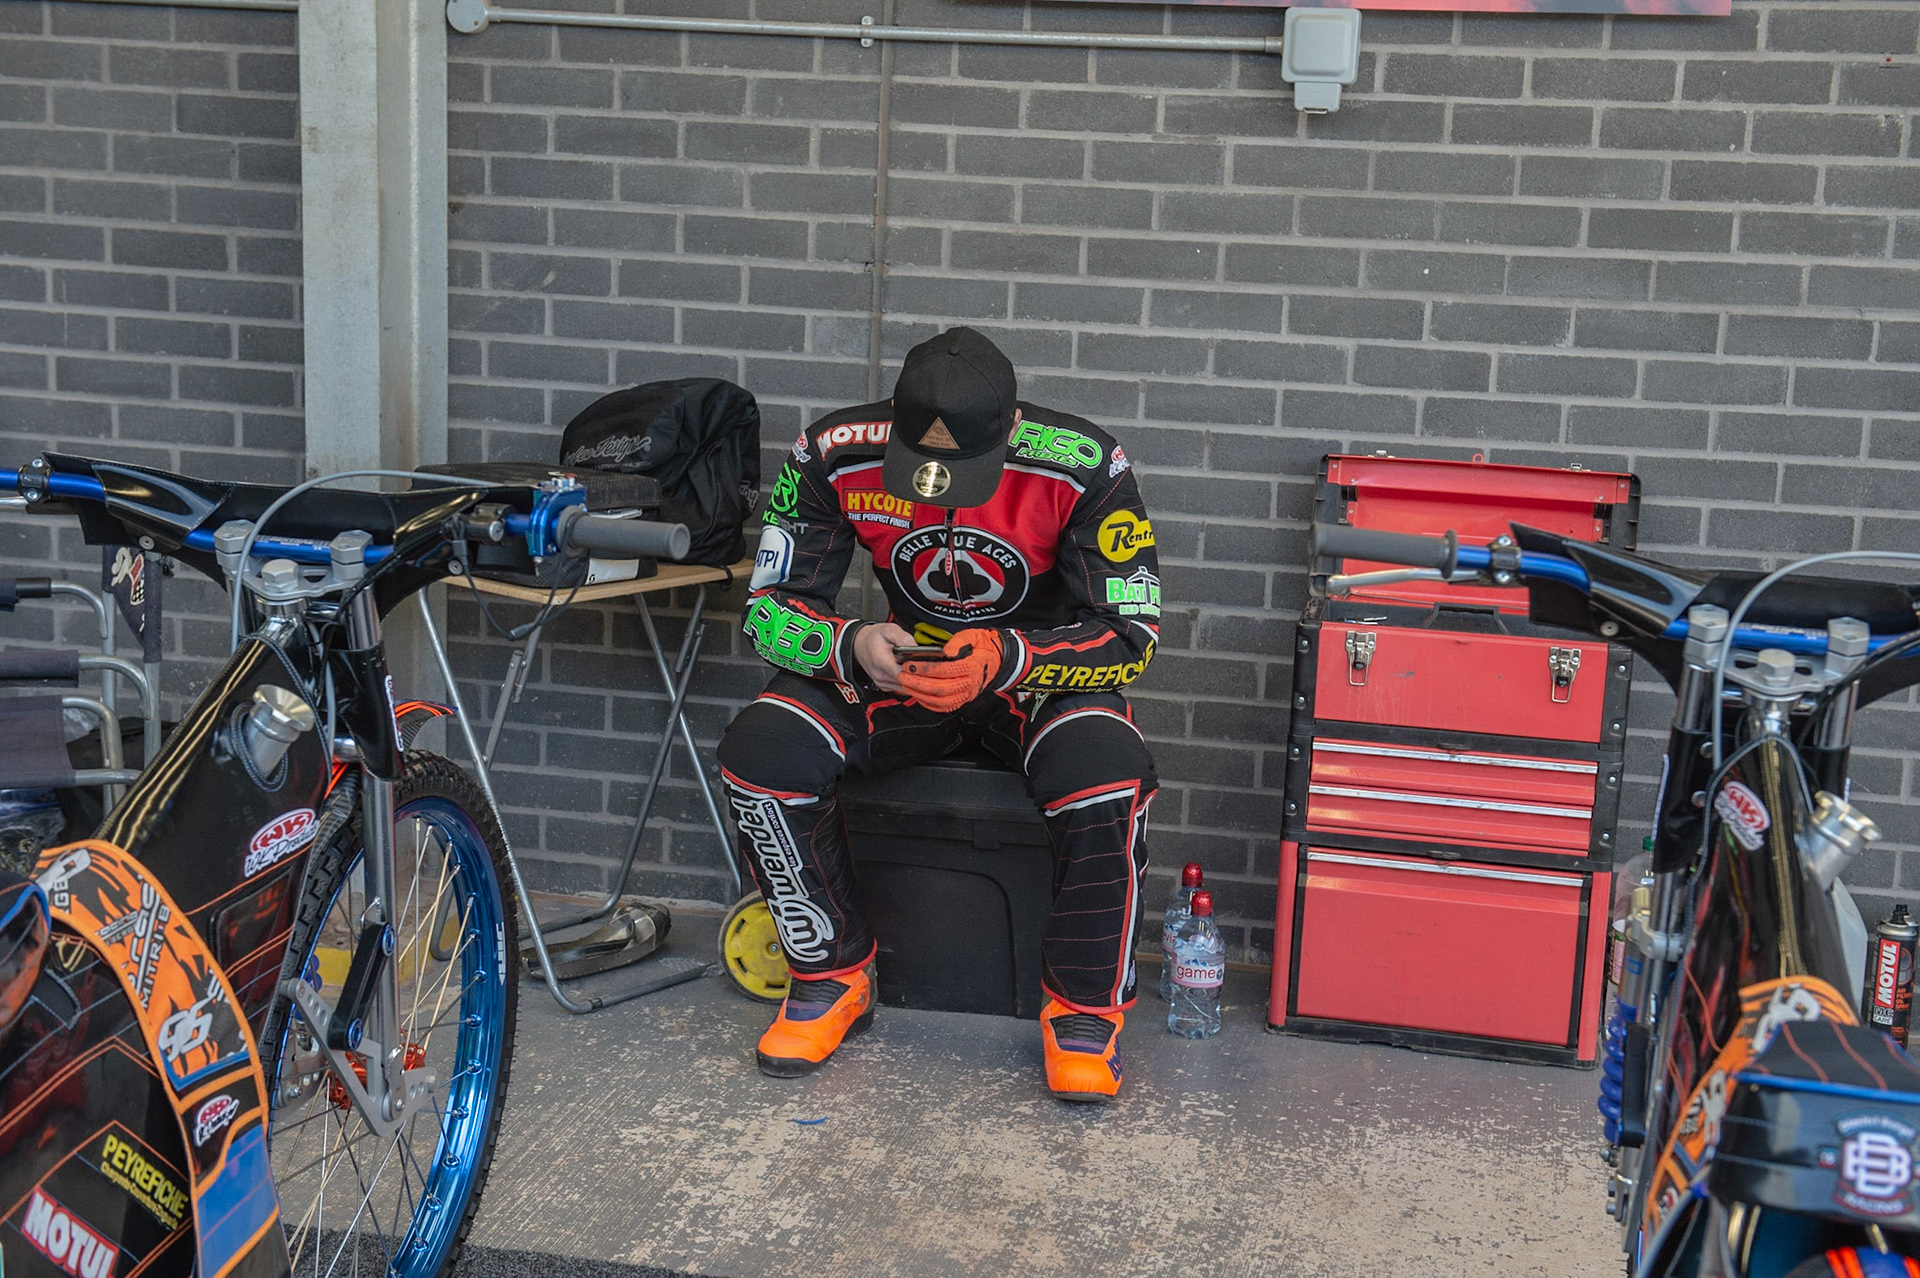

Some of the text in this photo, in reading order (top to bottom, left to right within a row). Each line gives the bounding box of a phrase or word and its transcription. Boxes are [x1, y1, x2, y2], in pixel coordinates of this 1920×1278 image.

[846, 492, 913, 517] HYCOTE
[848, 511, 911, 529] THE PERFECT FINISH
[899, 534, 934, 563] BELLE
[937, 532, 977, 550] VUE
[981, 543, 1017, 569] ACES
[1176, 964, 1216, 980] game
[1877, 943, 1898, 1006] MOTUL
[102, 1133, 189, 1219] PEYREFICHE
[23, 1190, 116, 1278] MOTUL
